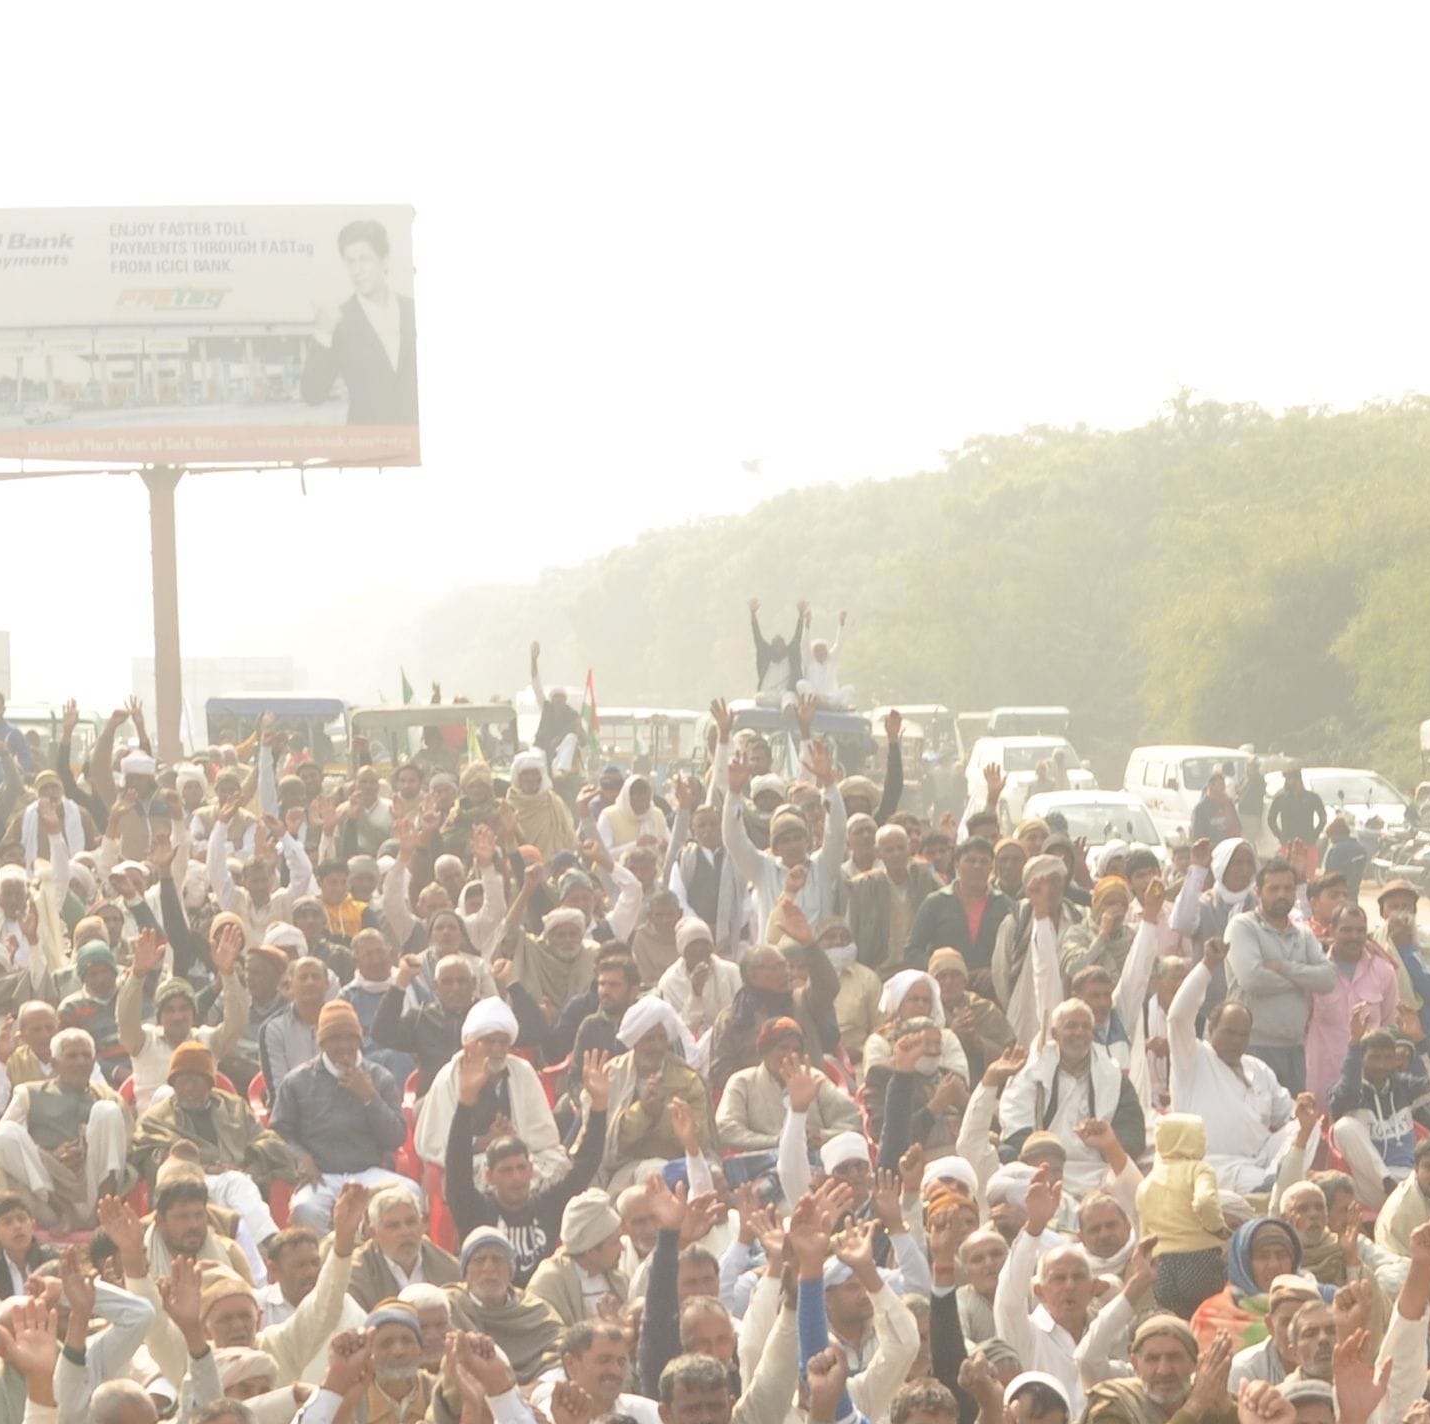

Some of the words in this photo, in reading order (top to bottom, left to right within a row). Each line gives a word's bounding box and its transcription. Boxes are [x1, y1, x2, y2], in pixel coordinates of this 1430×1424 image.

[109, 223, 155, 237] ENJOY
[159, 222, 211, 237] FASTER
[216, 222, 248, 236] TOLL
[7, 231, 75, 250] Bank
[109, 240, 187, 256] PAYMENTS
[191, 240, 257, 255] THROUGH
[261, 240, 315, 257] FASTag
[110, 259, 152, 273] FROM
[156, 259, 189, 273] ICICI
